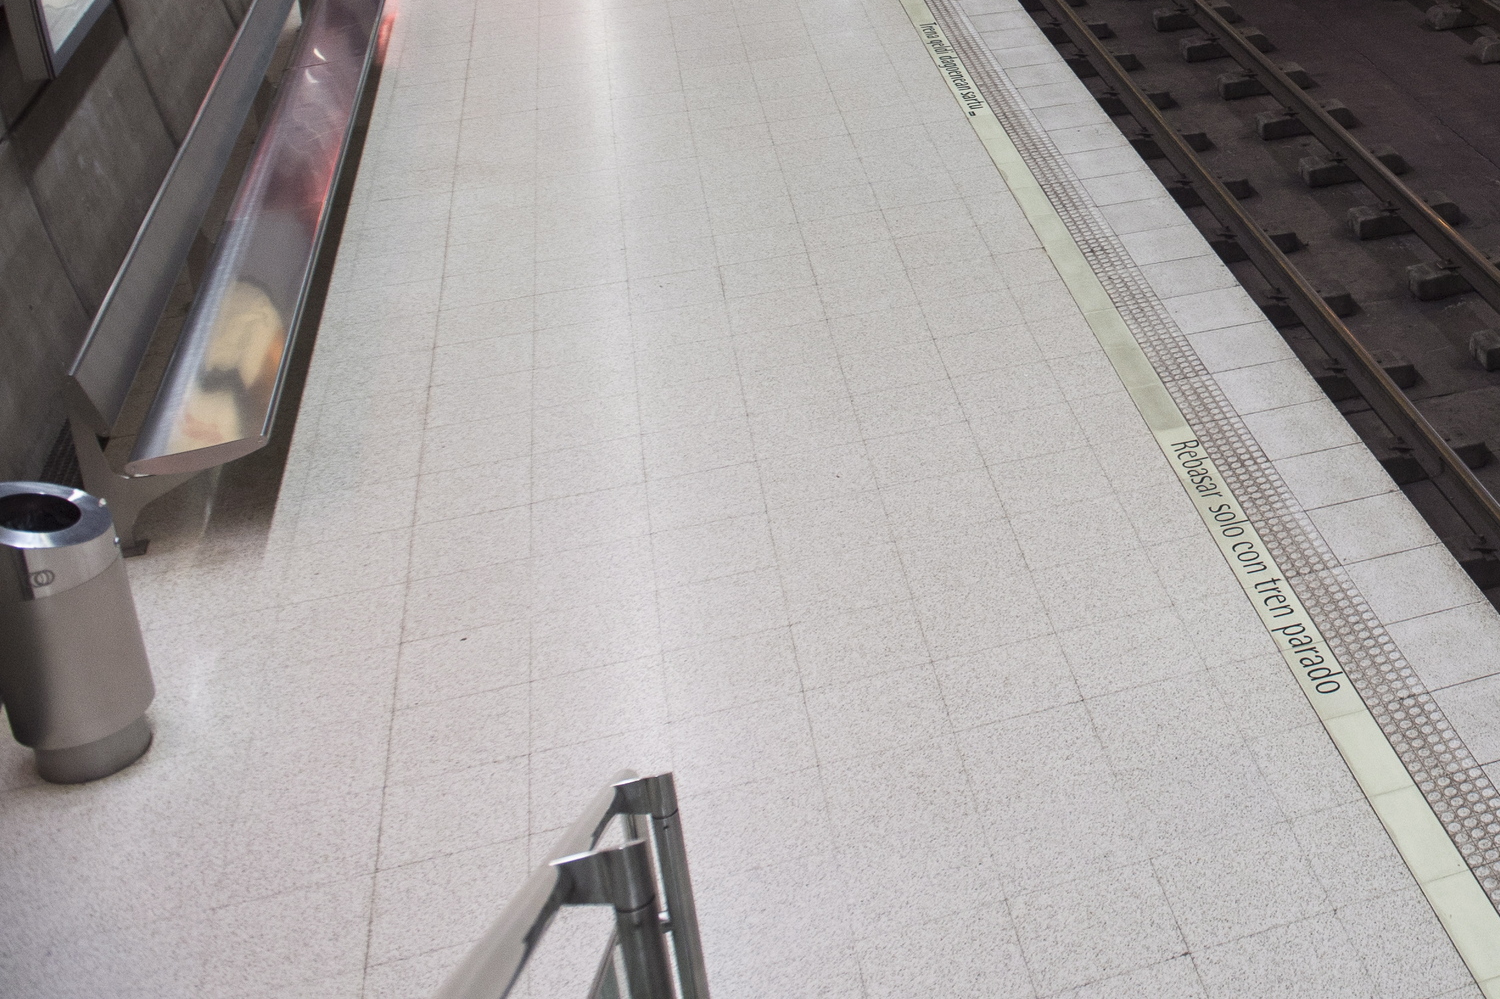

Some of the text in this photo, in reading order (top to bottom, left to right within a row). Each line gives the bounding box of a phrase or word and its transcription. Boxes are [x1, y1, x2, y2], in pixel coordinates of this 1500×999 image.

[919, 21, 940, 39] Trena
[938, 55, 972, 91] dagoenean
[1171, 438, 1344, 695] Rebasar solo con tren parado
